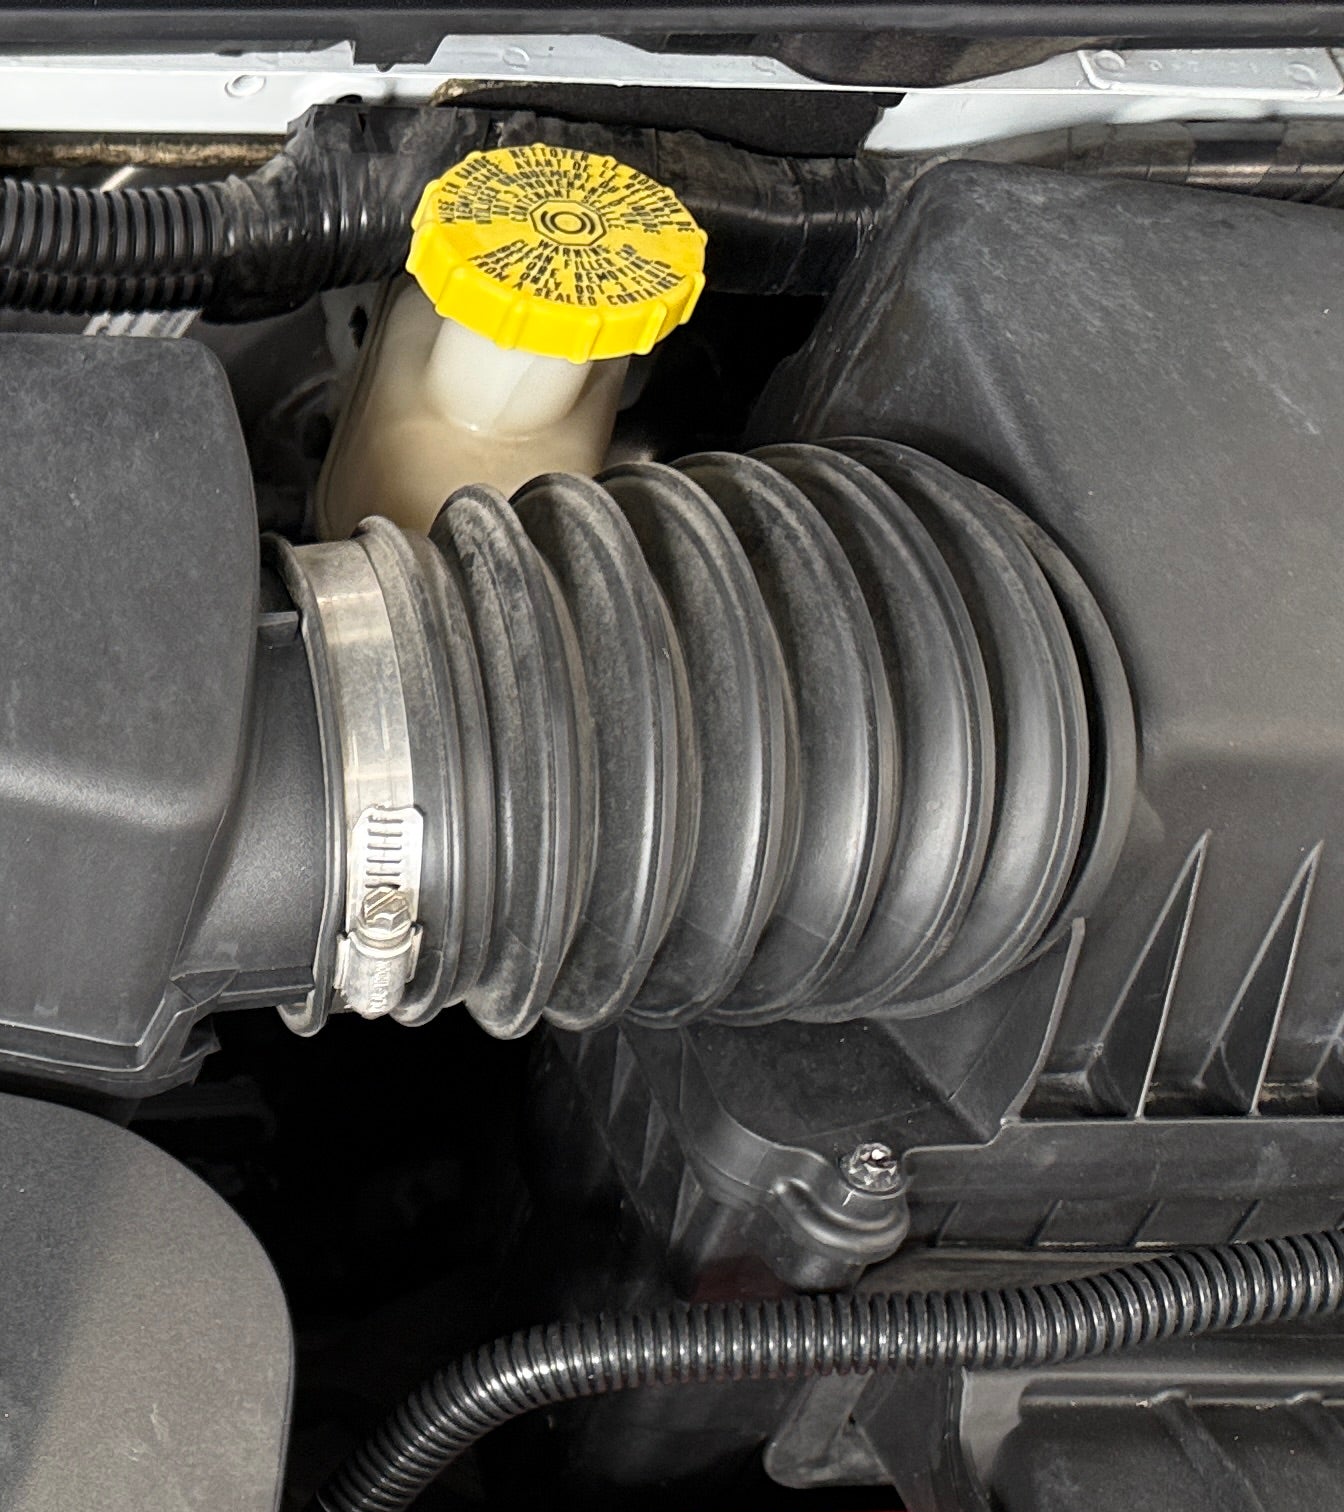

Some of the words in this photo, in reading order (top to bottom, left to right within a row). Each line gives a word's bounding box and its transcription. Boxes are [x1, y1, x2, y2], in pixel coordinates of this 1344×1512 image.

[563, 256, 617, 272] FILLER
[512, 280, 524, 292] A
[533, 287, 598, 306] SEALED
[574, 283, 605, 296] DOT
[614, 280, 627, 292] 3
